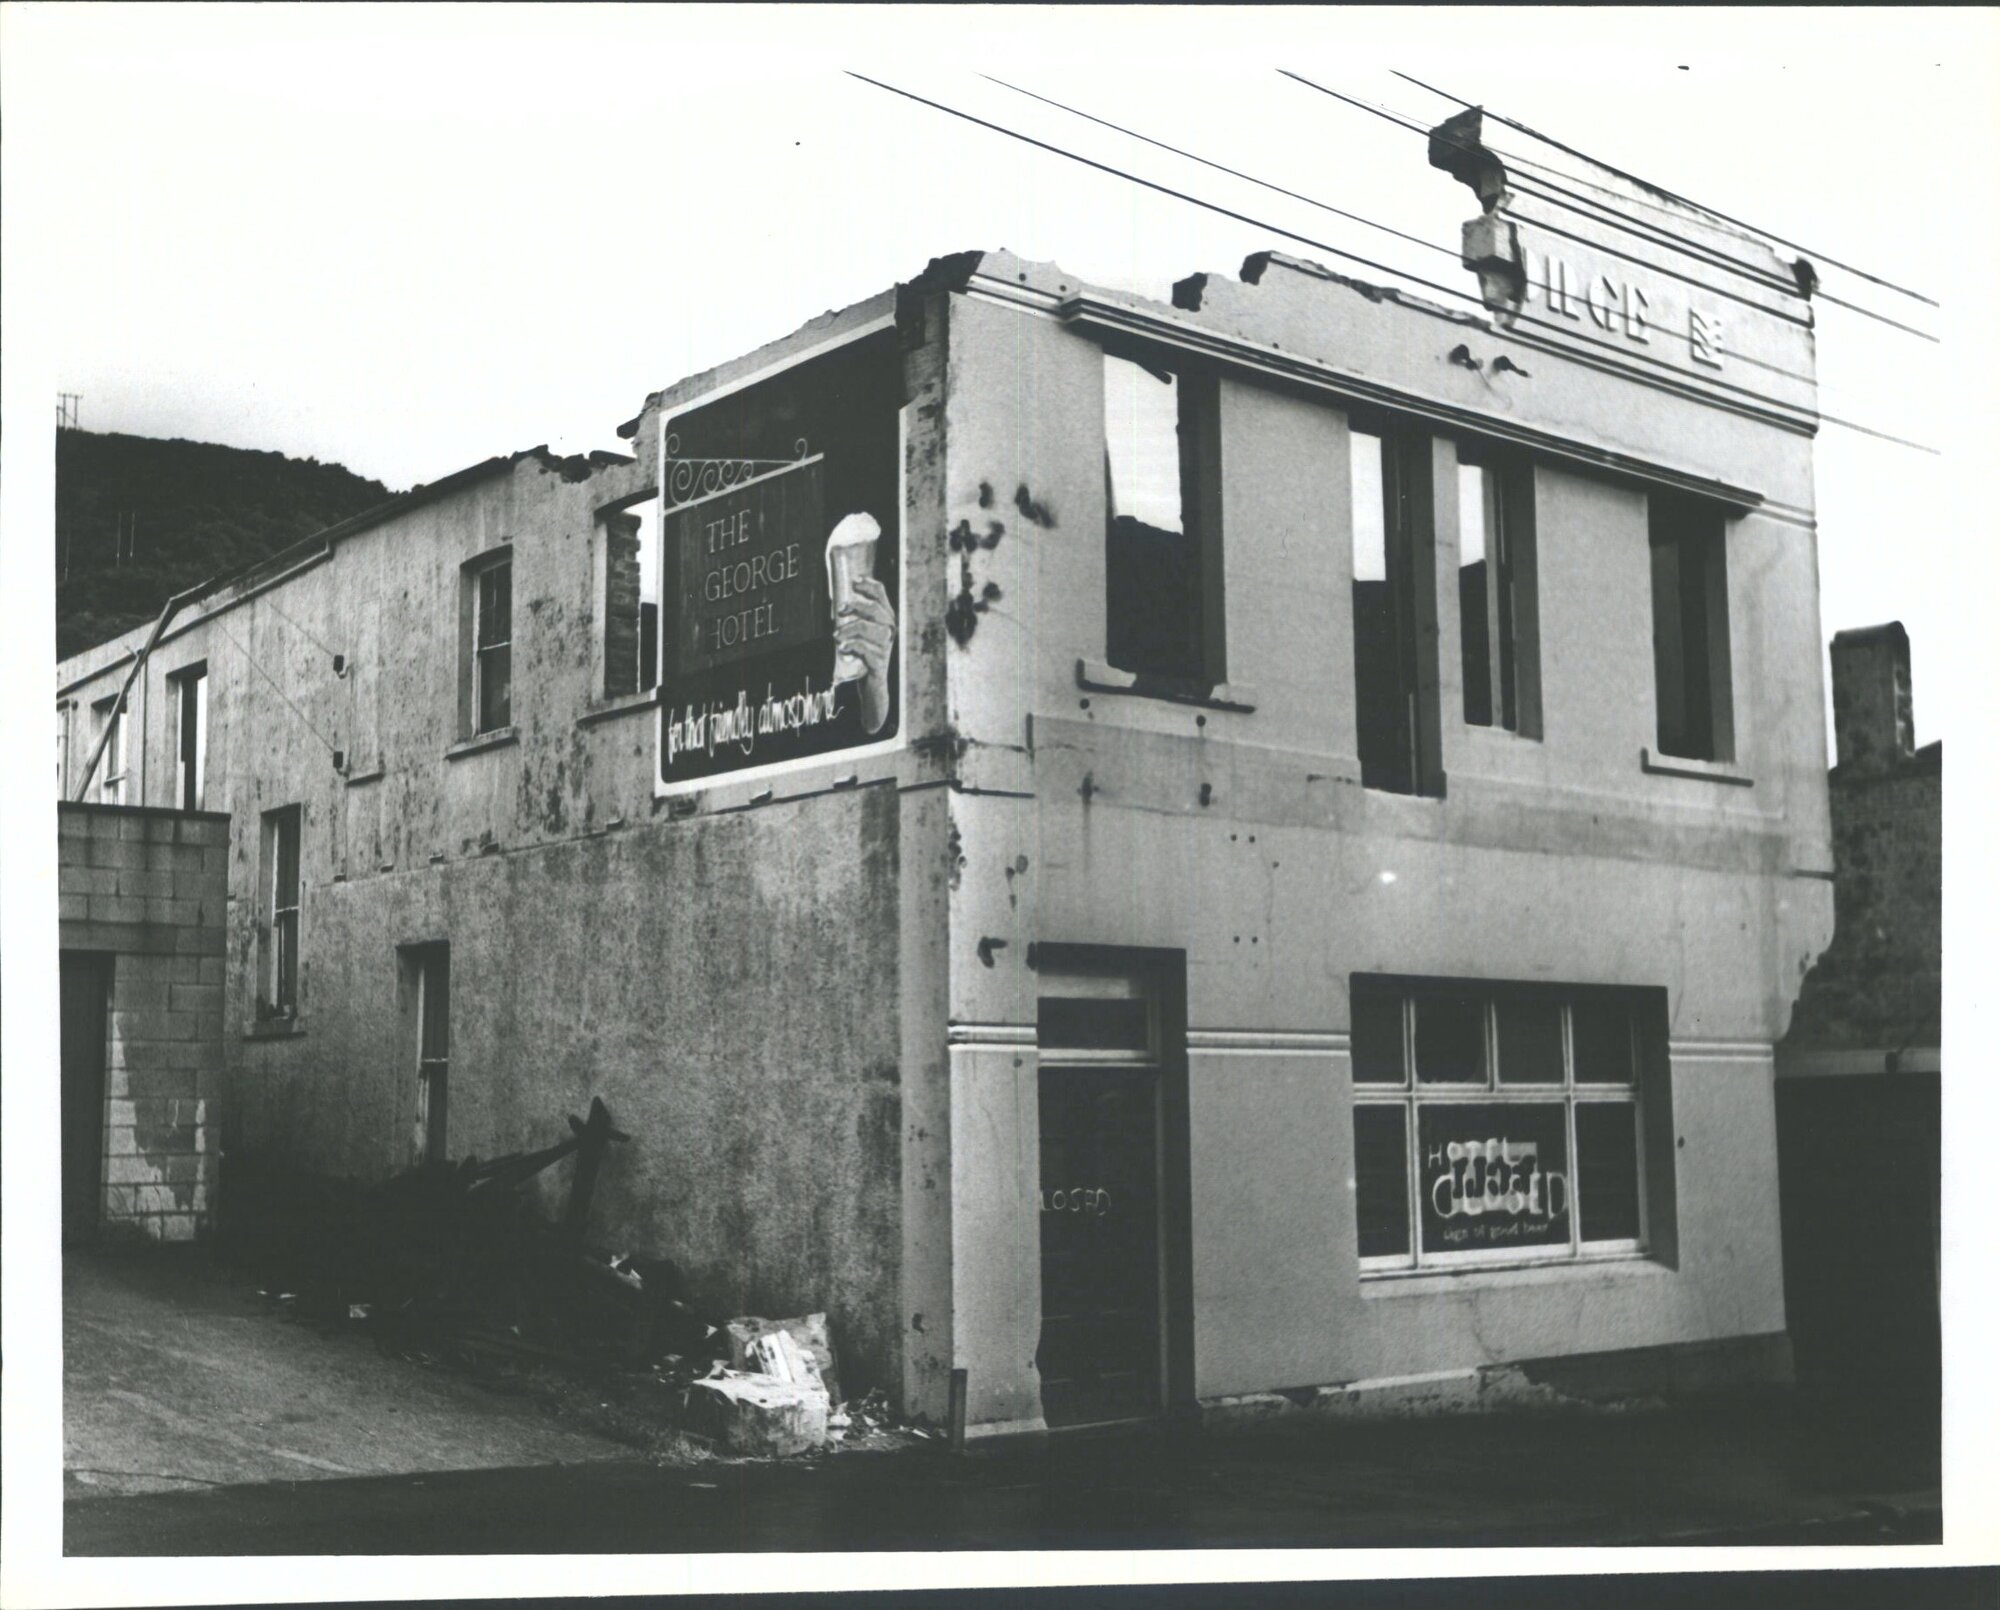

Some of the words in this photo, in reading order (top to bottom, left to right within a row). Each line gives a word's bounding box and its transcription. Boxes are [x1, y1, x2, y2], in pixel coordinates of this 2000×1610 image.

[705, 509, 752, 554] THE
[705, 543, 800, 601] GEORGE
[709, 690, 754, 758] friendly
[758, 676, 845, 738] atmosphere
[1040, 1187, 1112, 1216] LOSED
